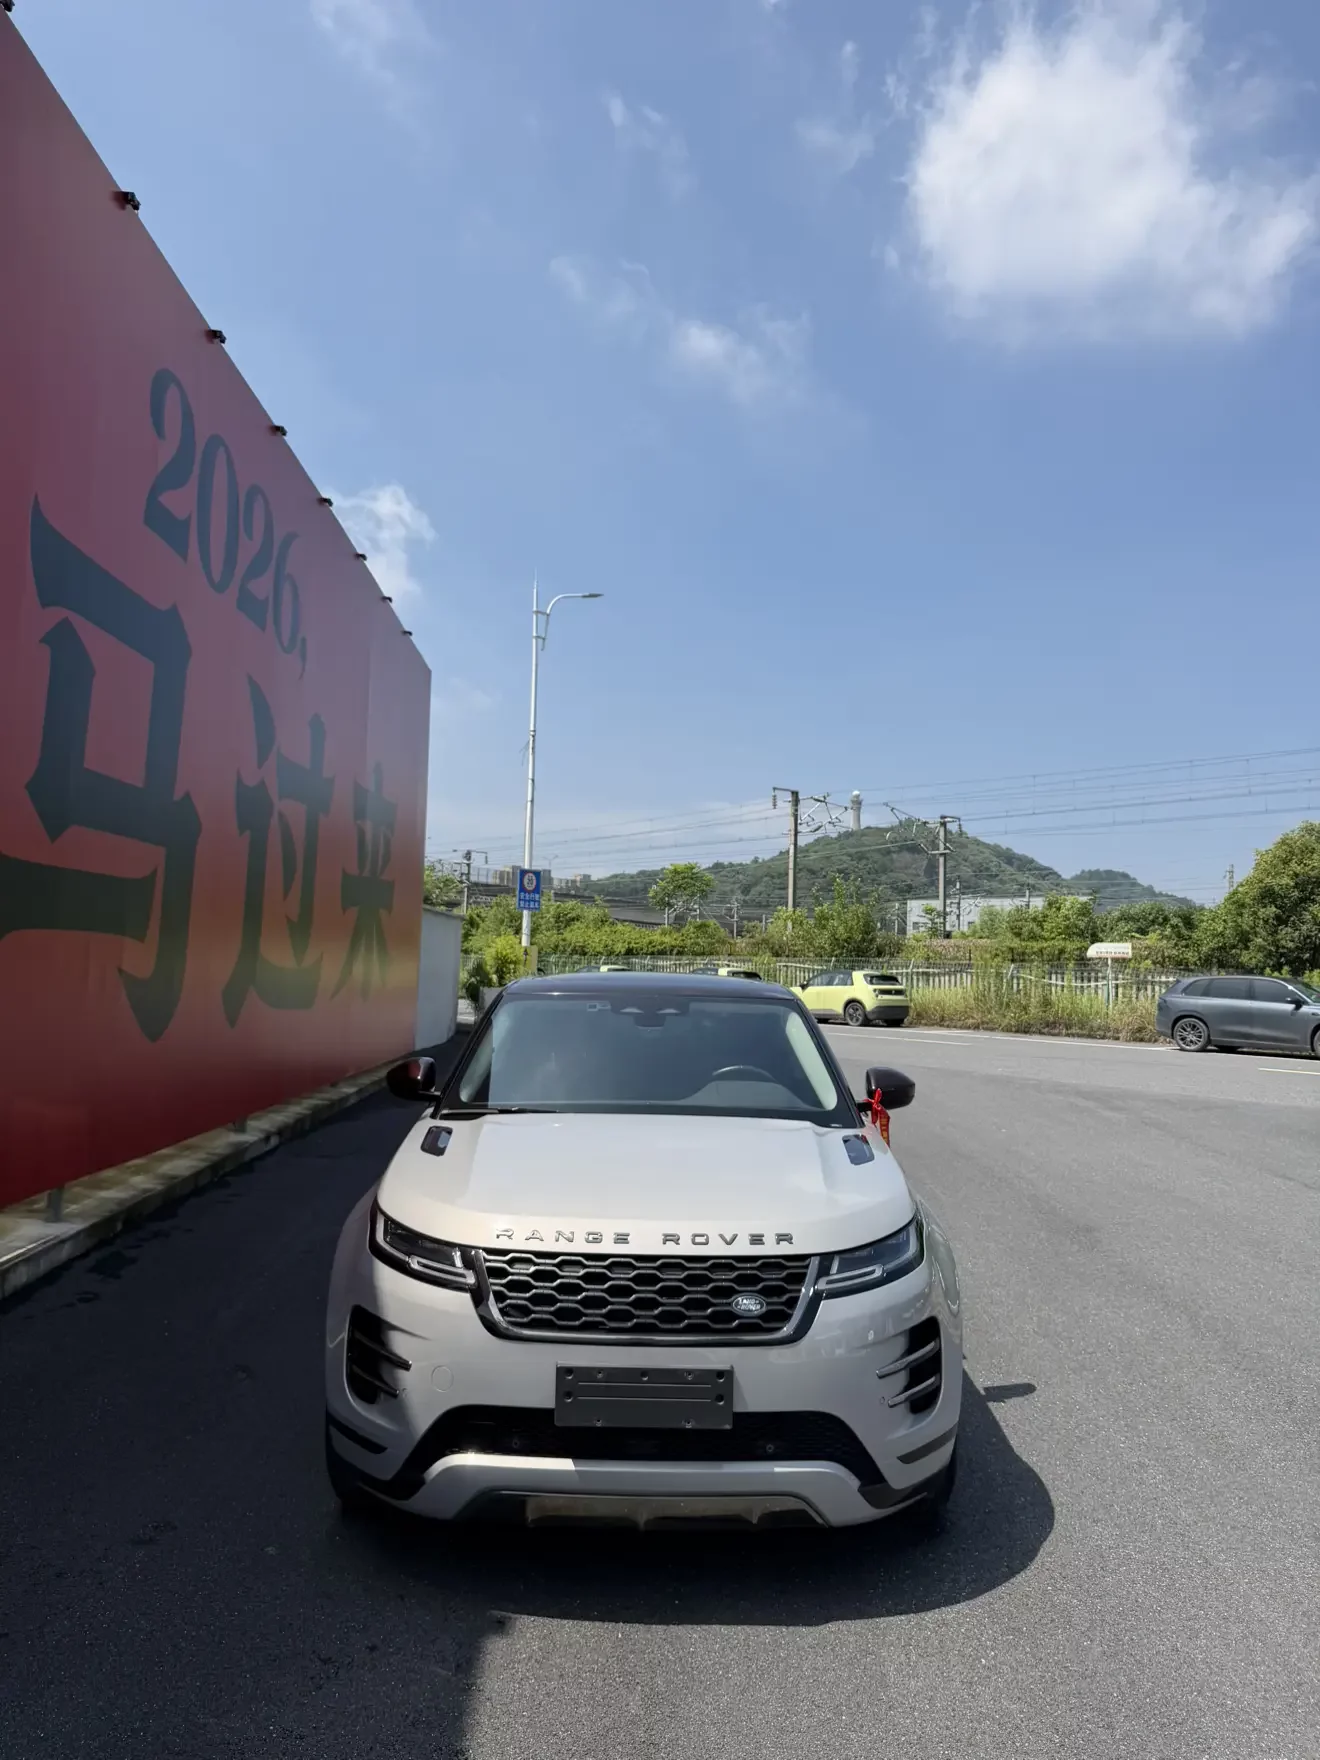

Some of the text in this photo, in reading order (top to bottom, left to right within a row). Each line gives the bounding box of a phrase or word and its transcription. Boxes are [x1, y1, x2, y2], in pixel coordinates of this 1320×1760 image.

[143, 368, 307, 681] 2026,
[496, 1228, 794, 1246] RANGE ROVER
